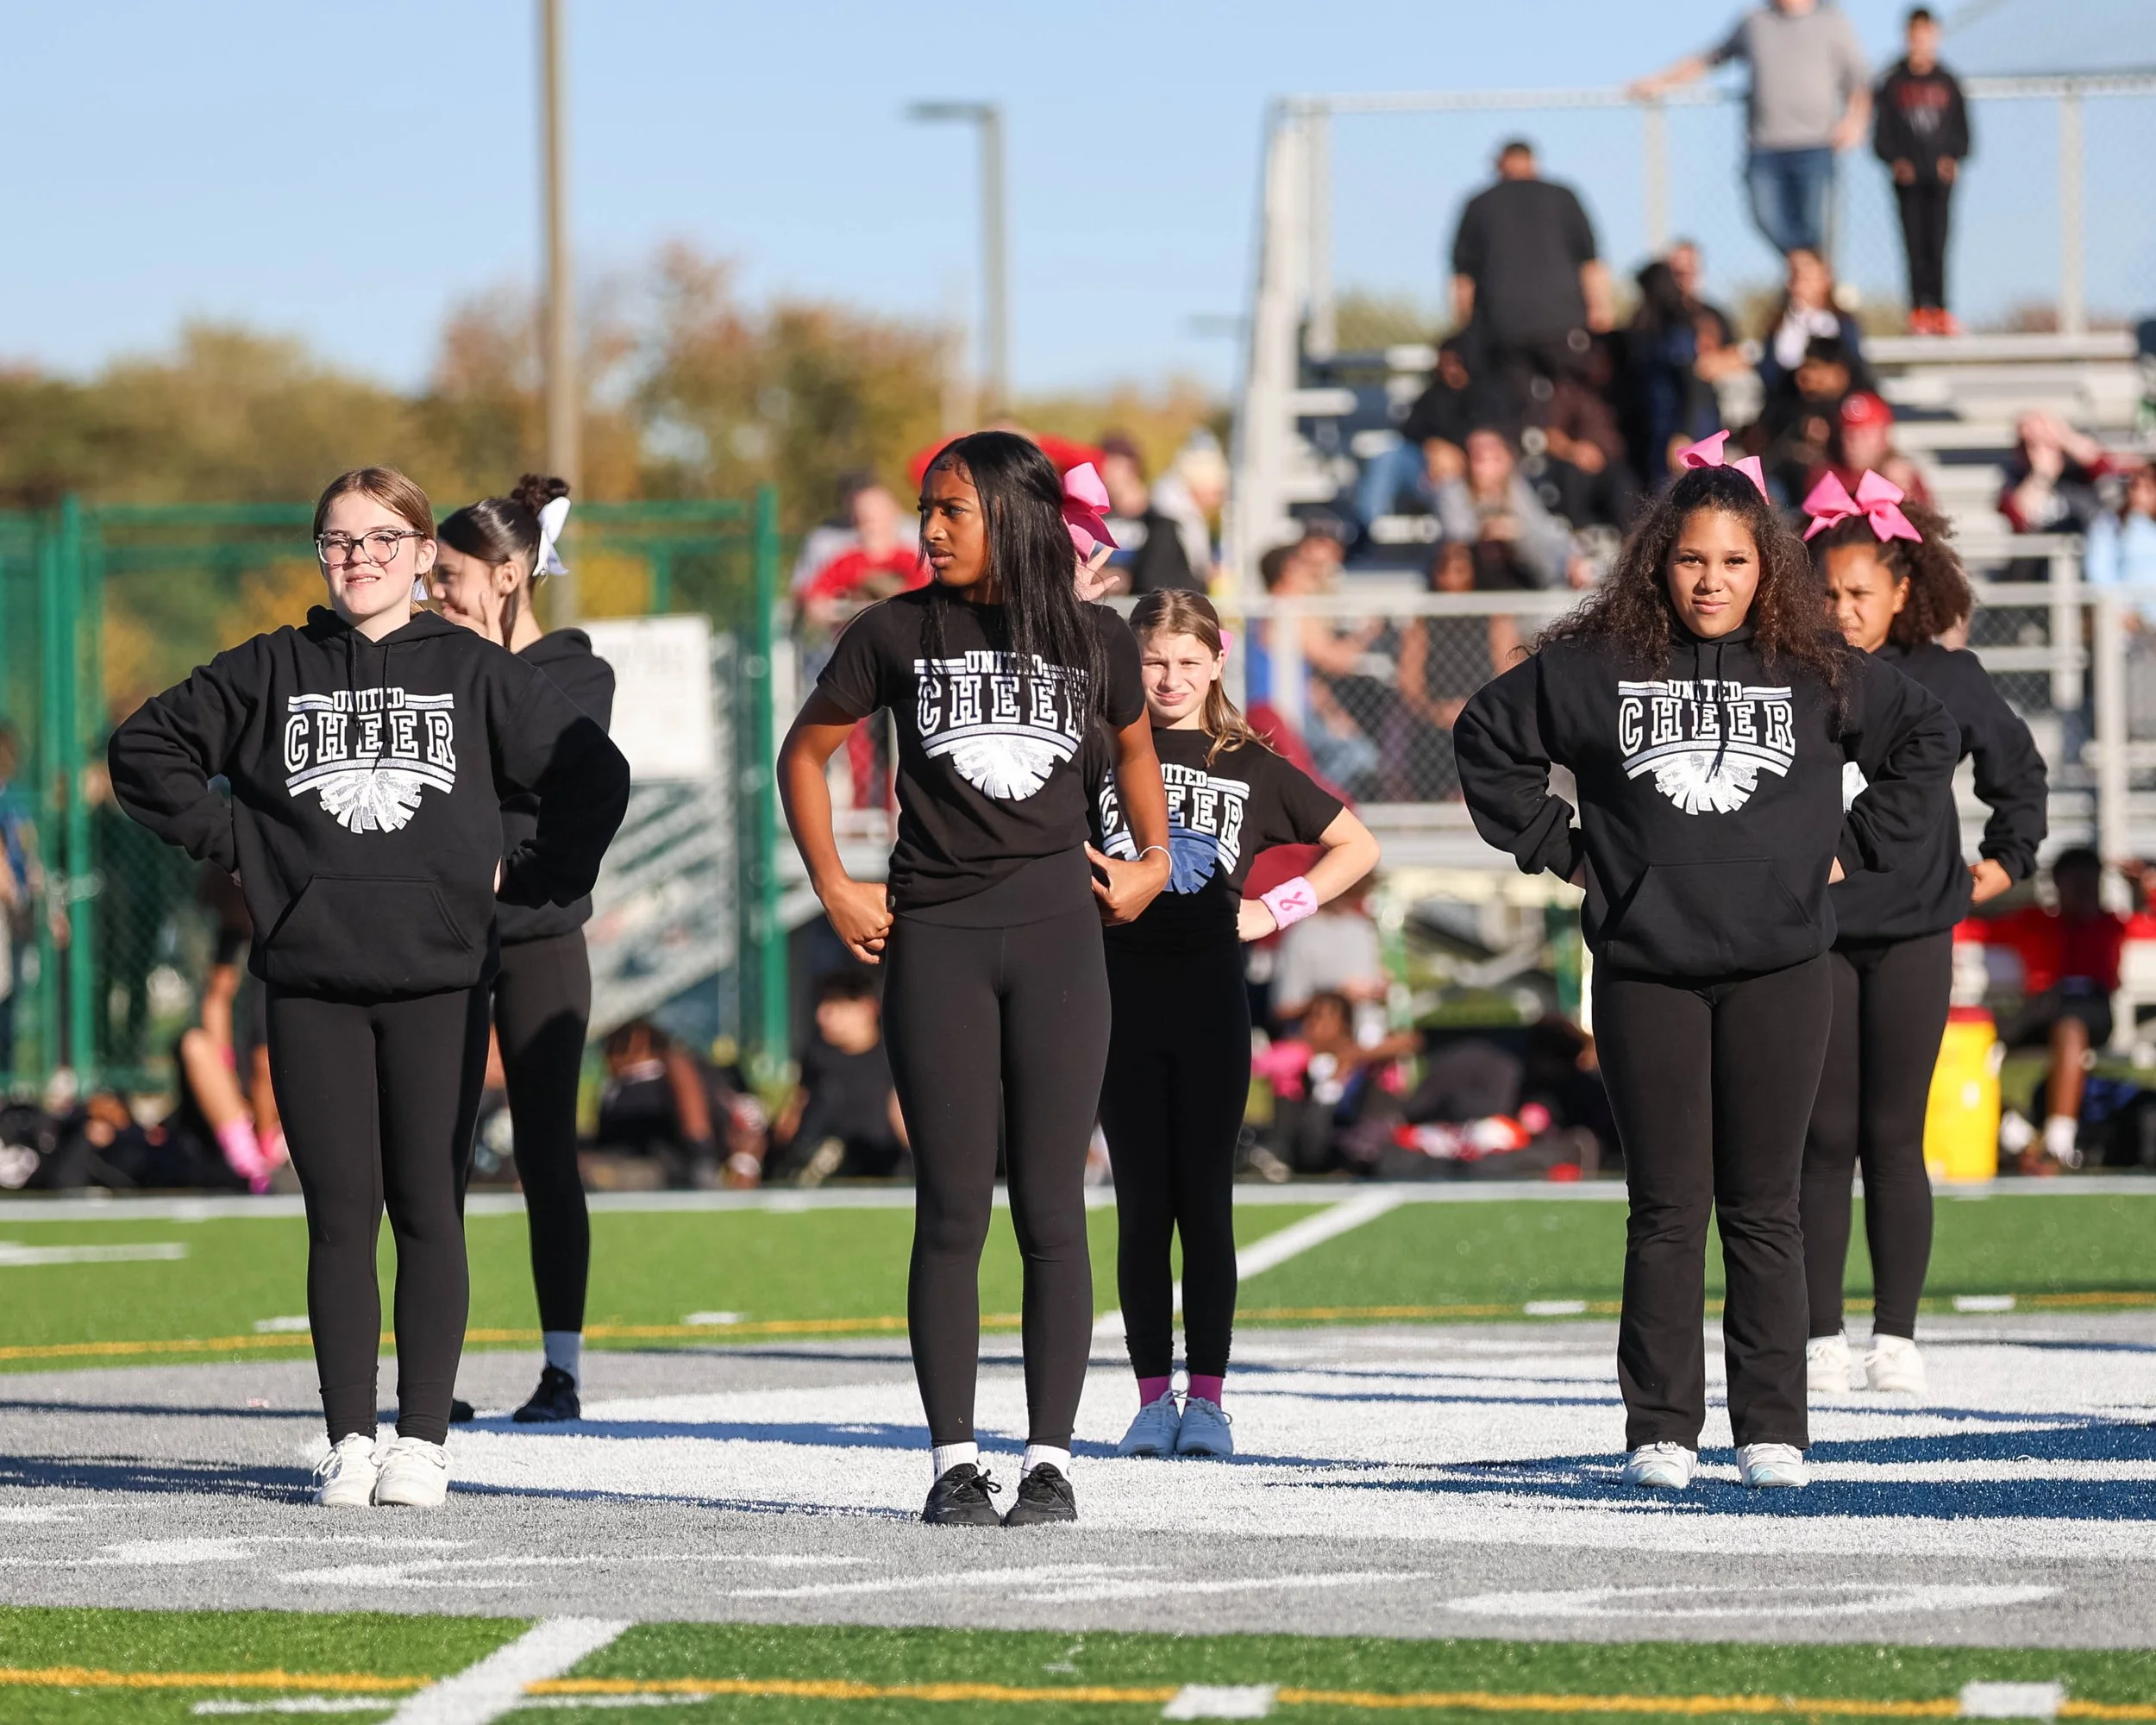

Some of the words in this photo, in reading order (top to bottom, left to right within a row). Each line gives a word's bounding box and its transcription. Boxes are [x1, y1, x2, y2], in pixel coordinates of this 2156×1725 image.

[285, 712, 456, 773] CHEER
[1619, 697, 1796, 756] CHEER
[1161, 763, 1208, 787] ITED
[1099, 784, 1244, 858] CEER
